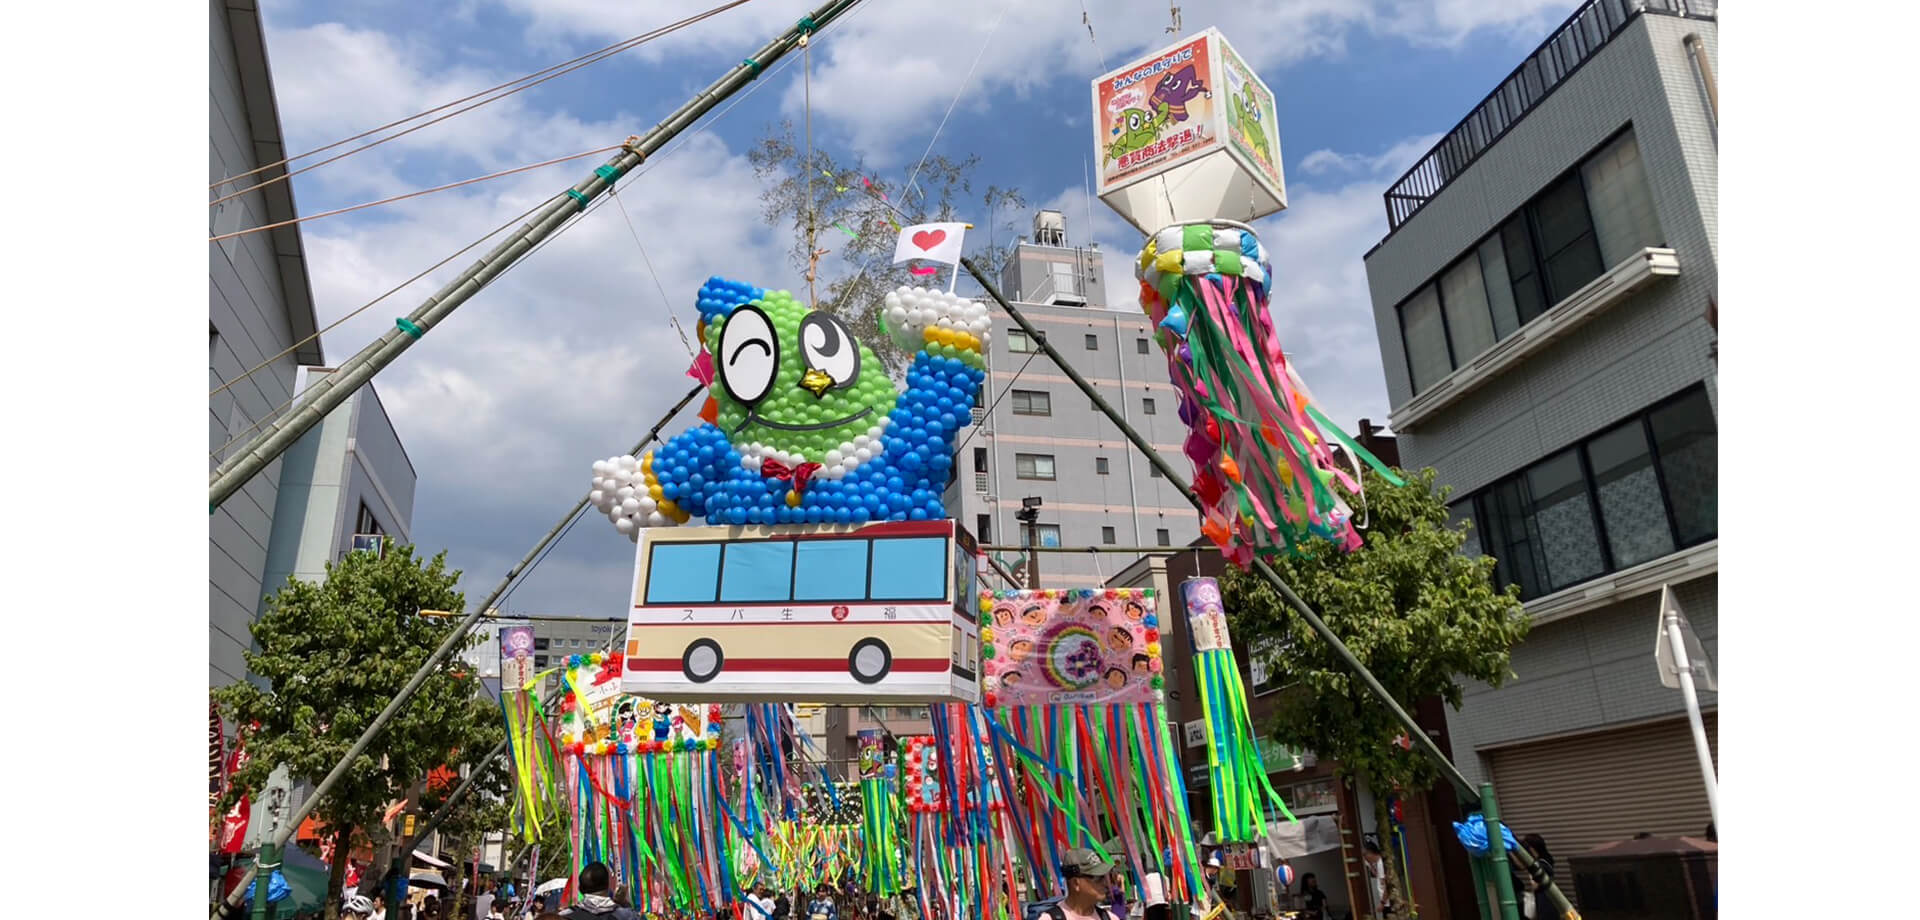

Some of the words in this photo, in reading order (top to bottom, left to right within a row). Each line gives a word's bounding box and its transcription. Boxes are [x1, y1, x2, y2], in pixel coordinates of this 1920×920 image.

[1113, 48, 1193, 91] みんなの見守りで
